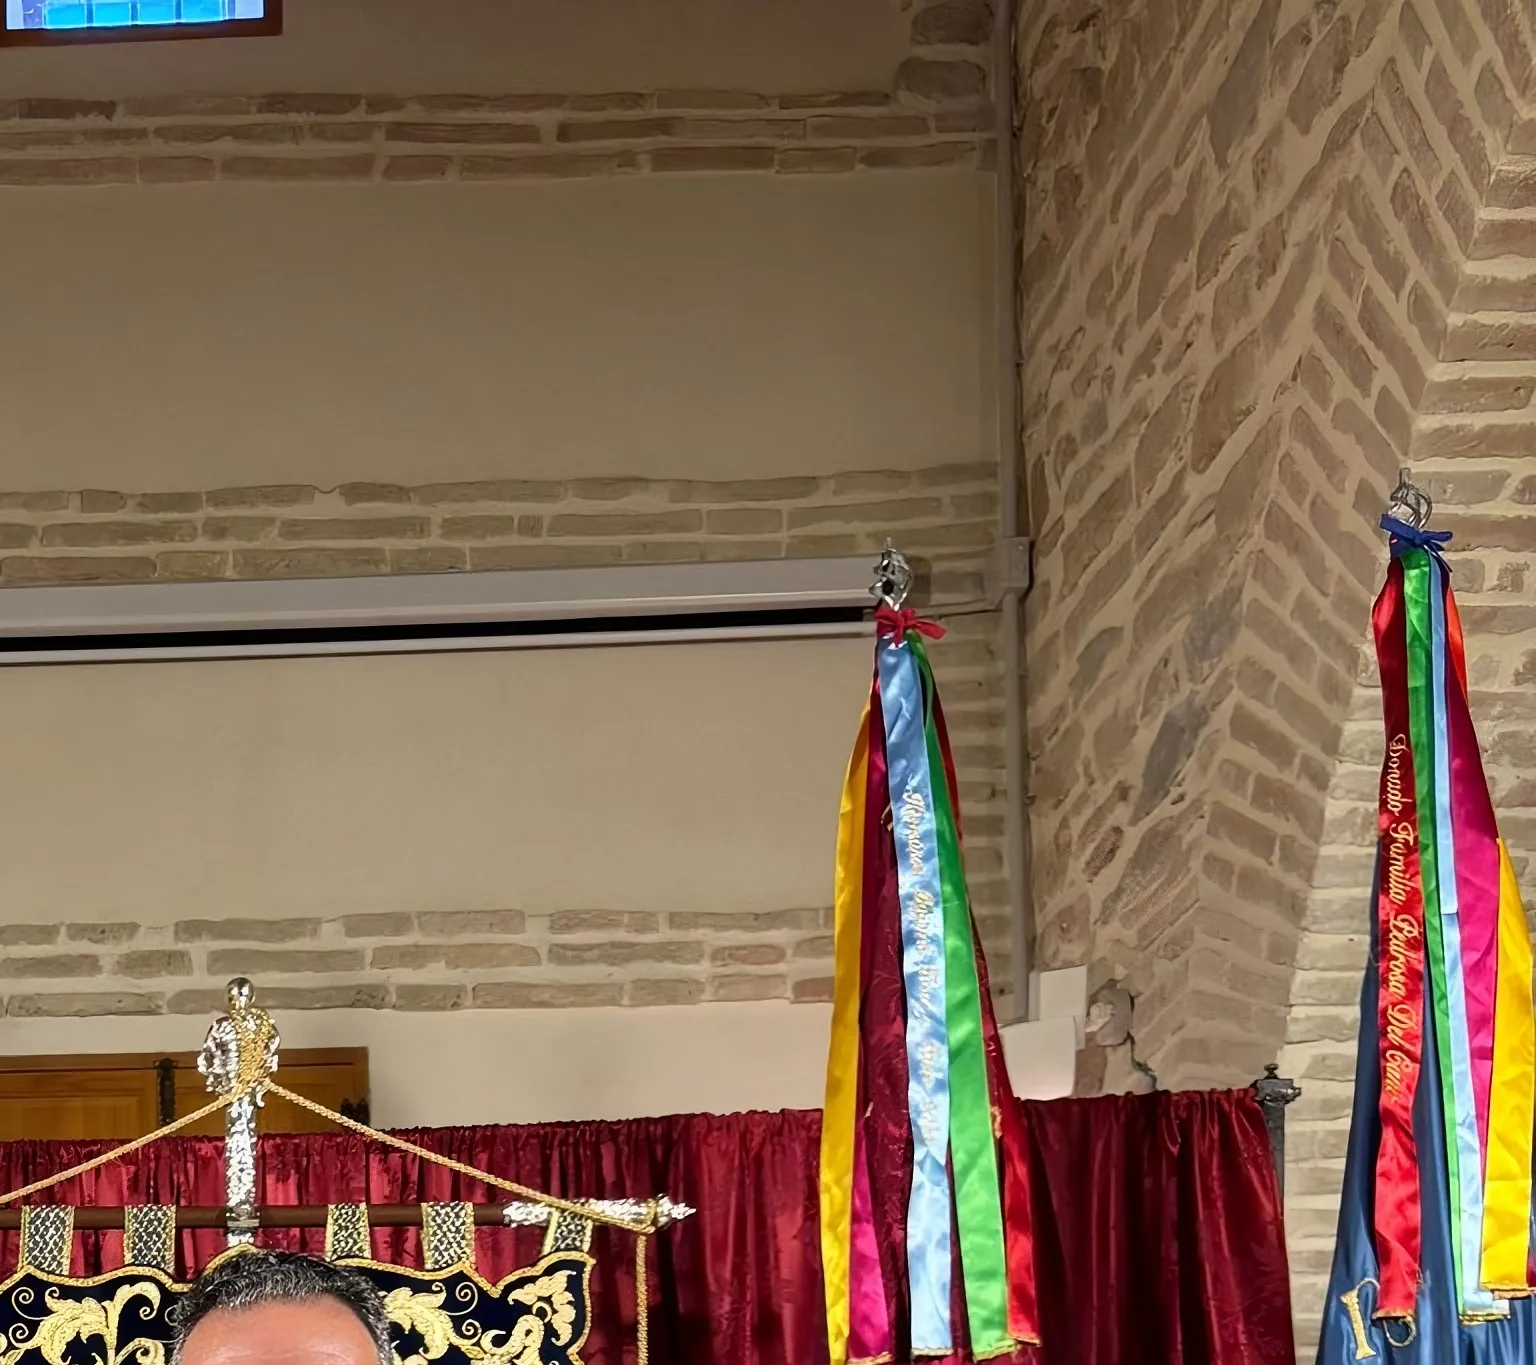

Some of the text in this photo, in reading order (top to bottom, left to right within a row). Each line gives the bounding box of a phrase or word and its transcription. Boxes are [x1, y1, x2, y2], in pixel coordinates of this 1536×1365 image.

[1389, 822, 1417, 904] Familia
[1388, 913, 1421, 1000] Pedrosa
[1386, 1004, 1418, 1046] Del
